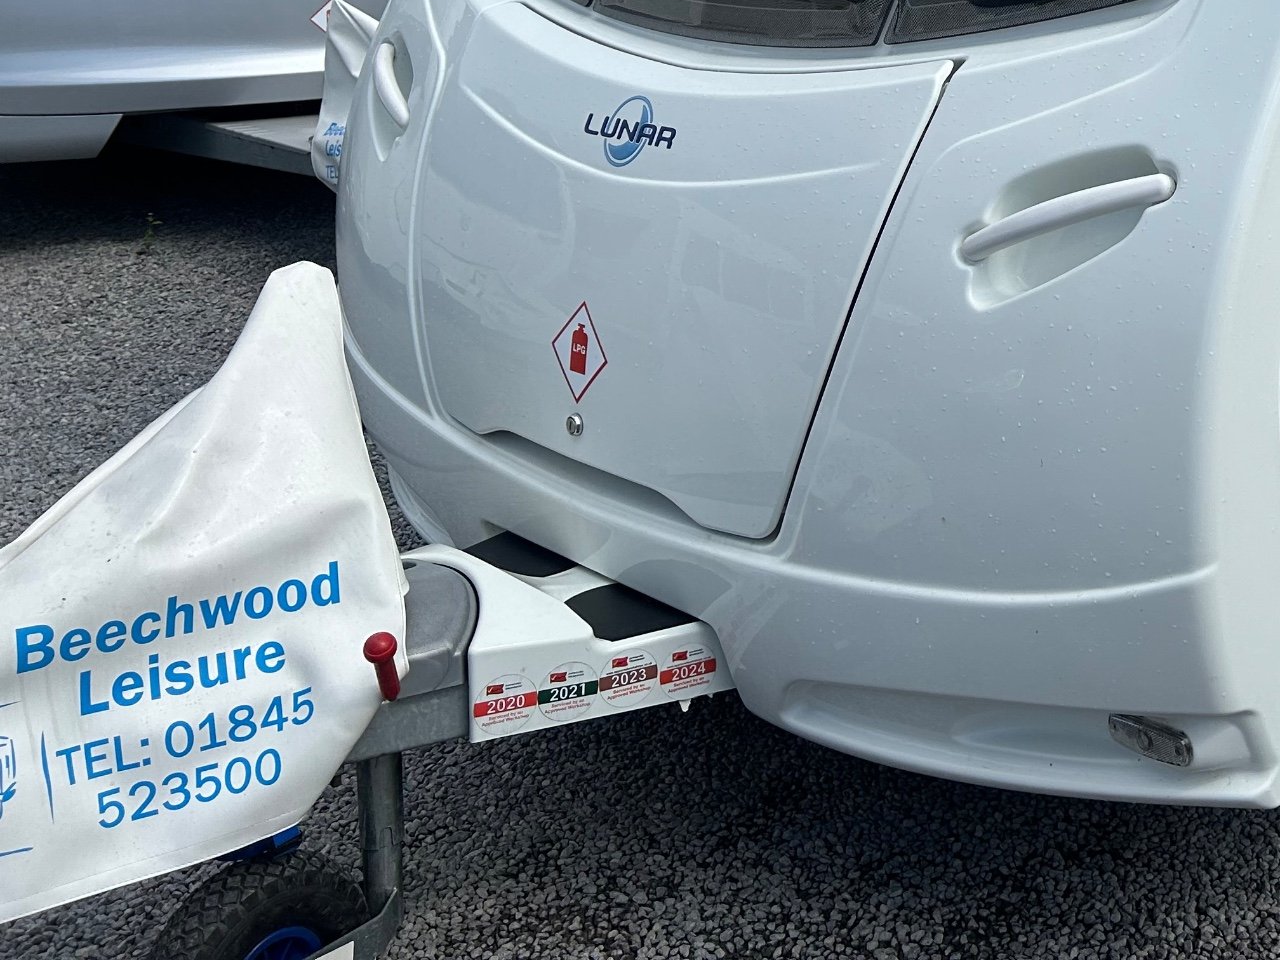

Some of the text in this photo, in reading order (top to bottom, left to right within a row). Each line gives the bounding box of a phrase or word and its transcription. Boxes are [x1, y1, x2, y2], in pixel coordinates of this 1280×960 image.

[584, 113, 677, 150] LUNAR
[572, 343, 586, 355] LPG
[16, 561, 342, 674] Beechwood
[79, 641, 287, 716] Leisure
[611, 668, 647, 688] 2023
[672, 661, 706, 681] 2024
[487, 694, 525, 714] 2020
[549, 683, 586, 702] 2021
[55, 687, 316, 786] TEL: 01845
[97, 748, 283, 829] 523500
